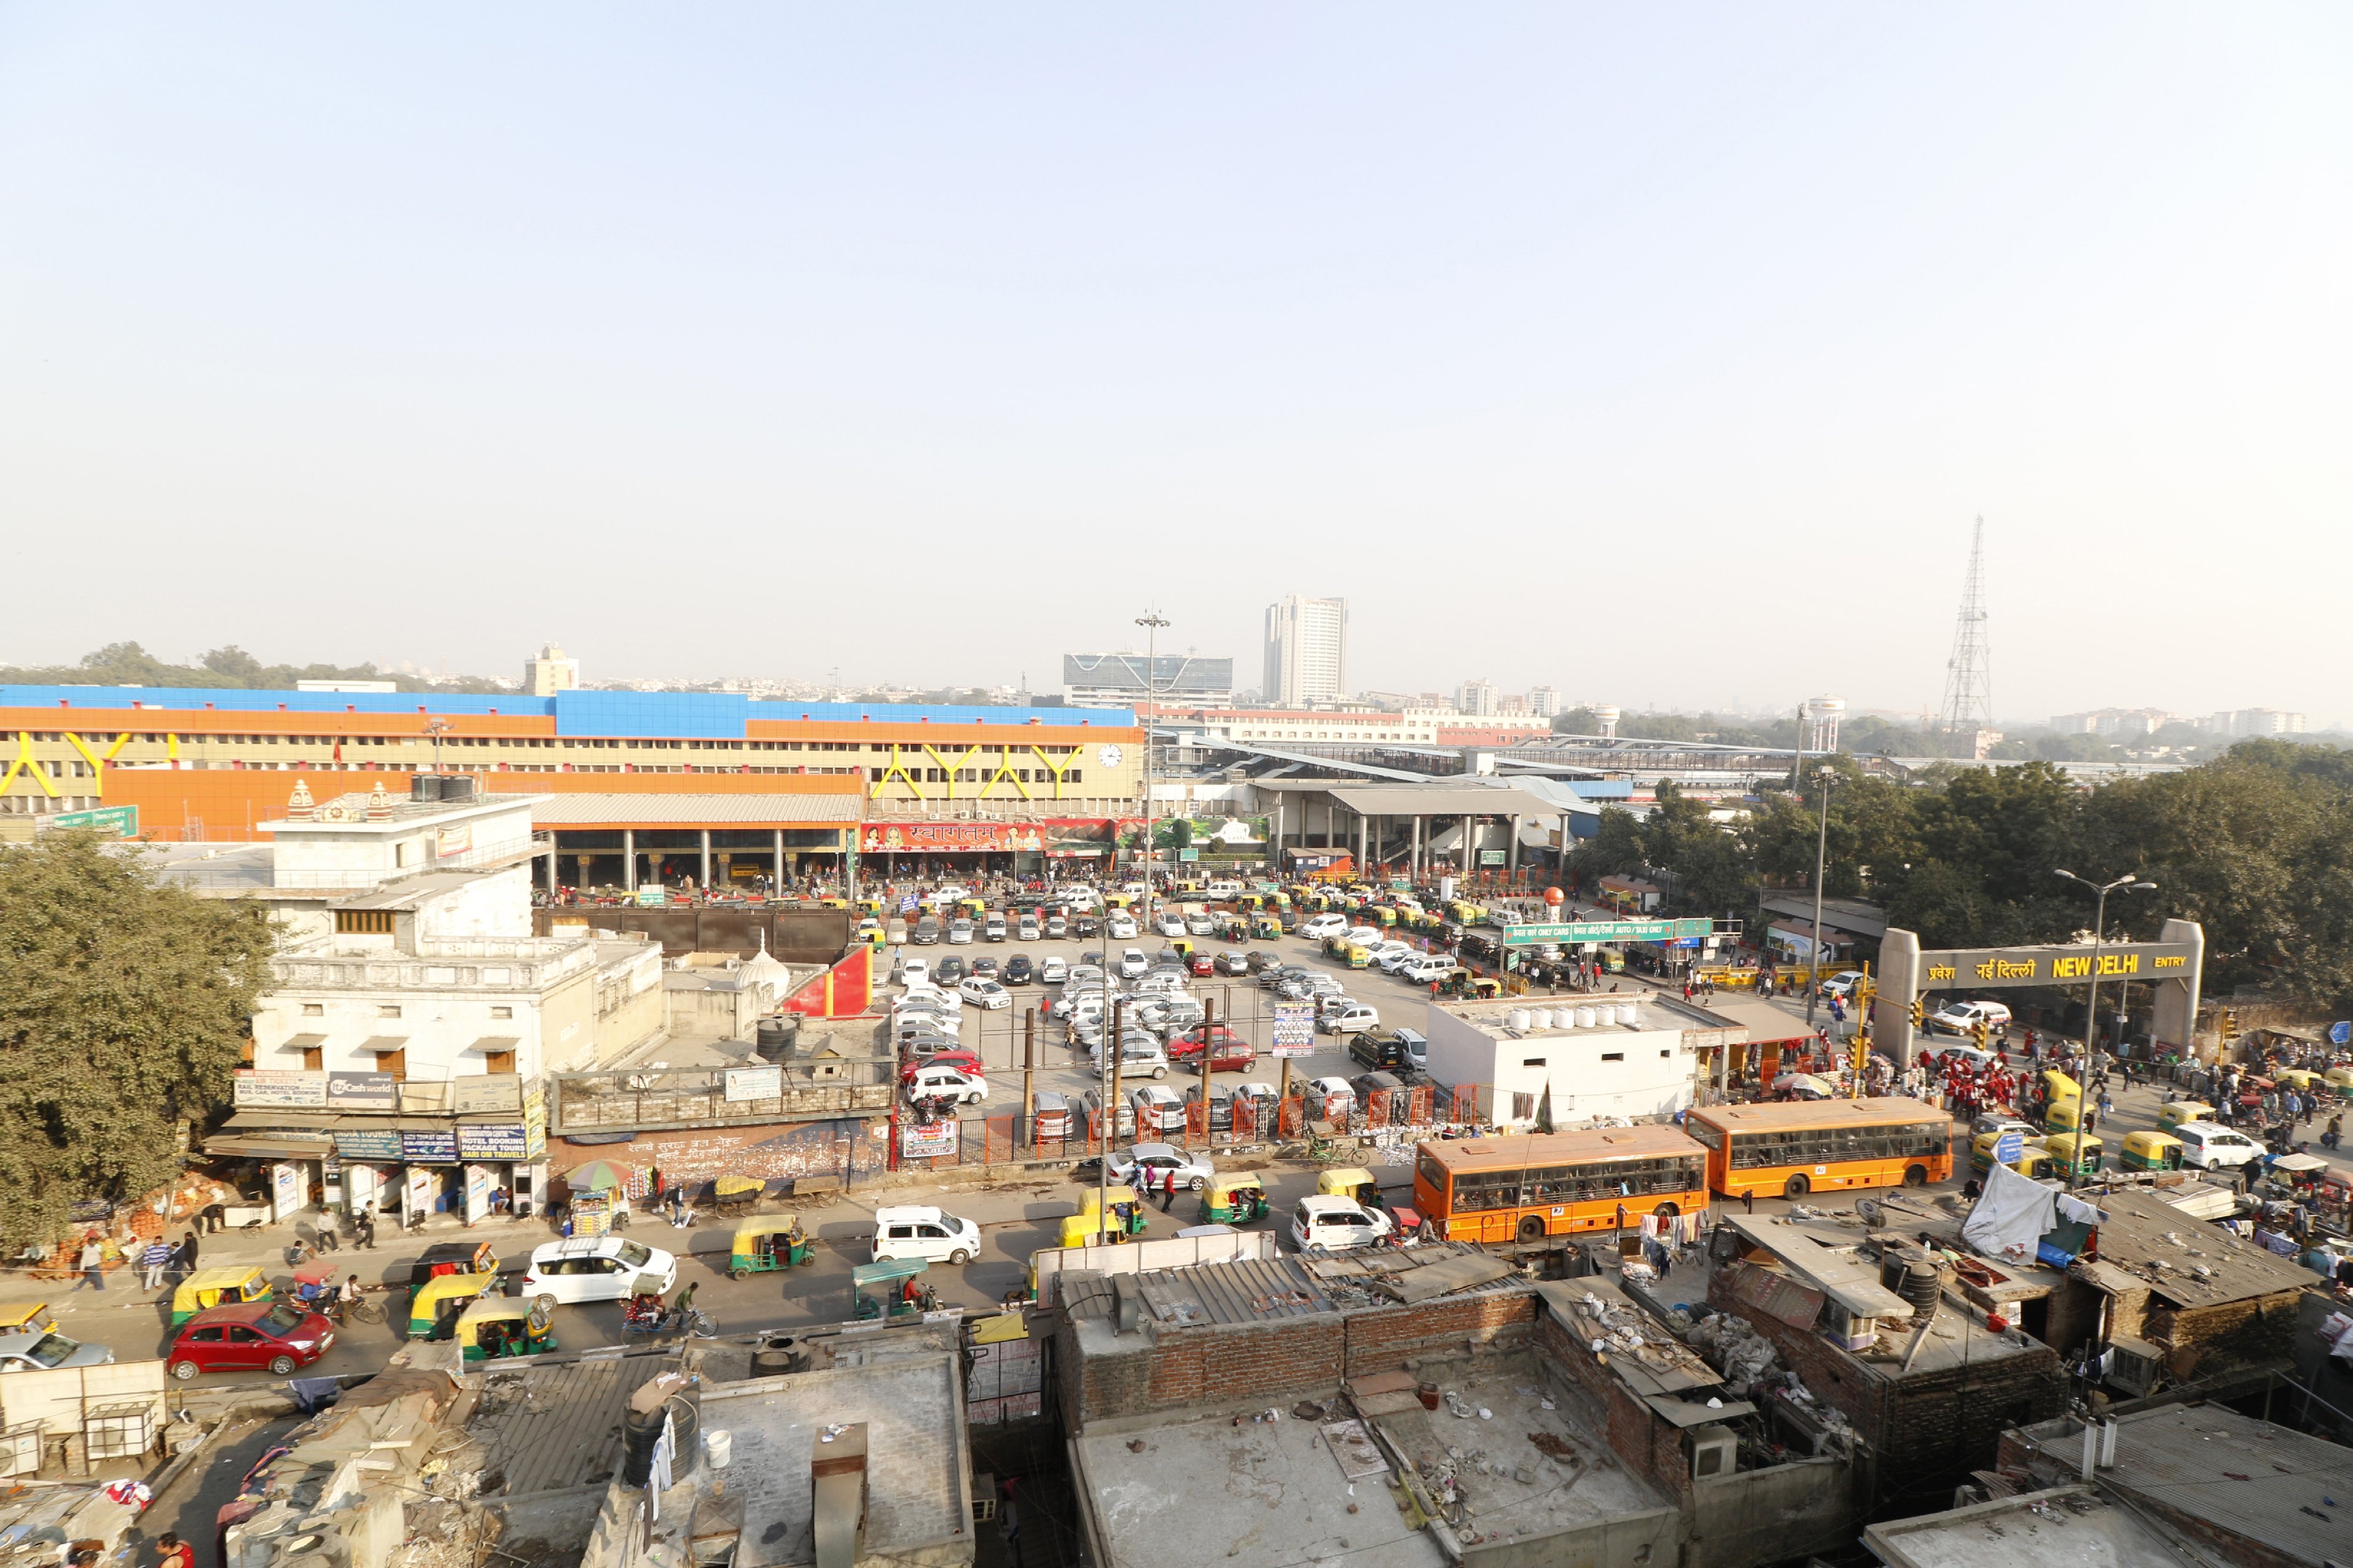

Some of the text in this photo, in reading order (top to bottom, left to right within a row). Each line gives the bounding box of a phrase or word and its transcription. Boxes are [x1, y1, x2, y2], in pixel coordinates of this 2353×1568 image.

[910, 826, 997, 843] स्वागतम्
[1513, 927, 1525, 937] केवल
[1554, 927, 1569, 936] CARS
[1573, 926, 1586, 935] केवल
[1928, 954, 2187, 981] प्रवेश नई दिल्ली NEW DELHI ENTRY
[628, 1141, 654, 1152] रेलवे
